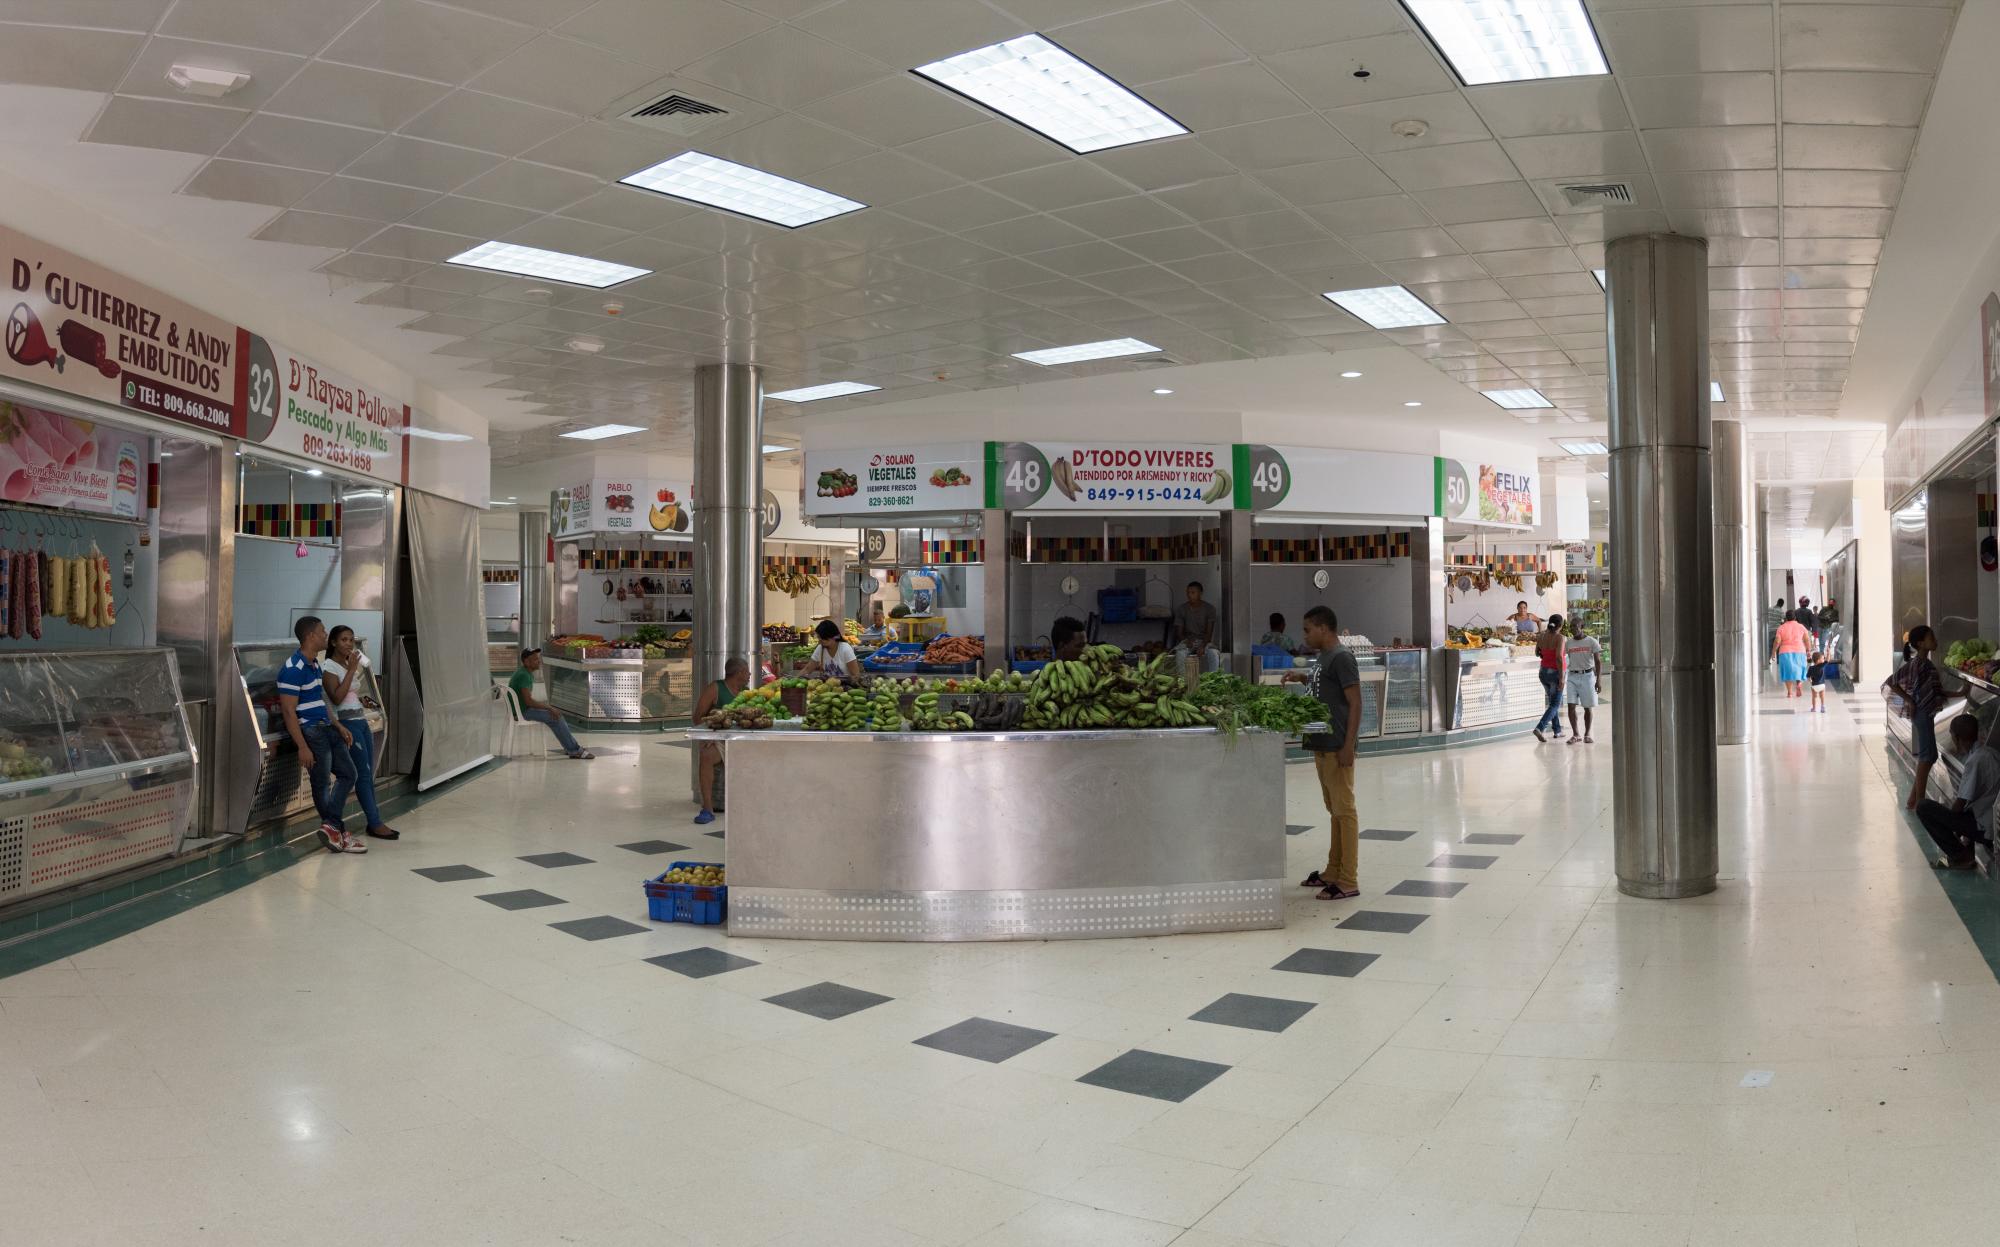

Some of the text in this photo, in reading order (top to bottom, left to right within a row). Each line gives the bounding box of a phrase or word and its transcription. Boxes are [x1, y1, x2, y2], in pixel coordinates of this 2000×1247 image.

[167, 322, 179, 348] &
[185, 328, 230, 367] ANDY
[119, 333, 219, 392] EMBUTIDOS
[250, 363, 274, 417] 32
[139, 385, 230, 427] TEL: 809.668.2004
[288, 398, 388, 452] Pescado y Algo Más
[303, 433, 372, 472] 809-263-1858
[1073, 450, 1214, 468] D'TODO VIVERES
[869, 467, 916, 481] VEGETALES
[1005, 461, 1041, 492] 48
[1074, 470, 1213, 482] ATENDIDO POR ARISMENDY Y RICKY
[1253, 462, 1282, 493] 49
[1496, 472, 1530, 493] FELIX
[573, 484, 590, 500] PABLO
[607, 483, 632, 491] PABLO
[1087, 488, 1201, 500] 849-915-0424
[1448, 476, 1465, 505] 50
[1487, 487, 1531, 505] VEGETALES
[607, 517, 632, 527] VEGETALES
[868, 535, 882, 551] 66
